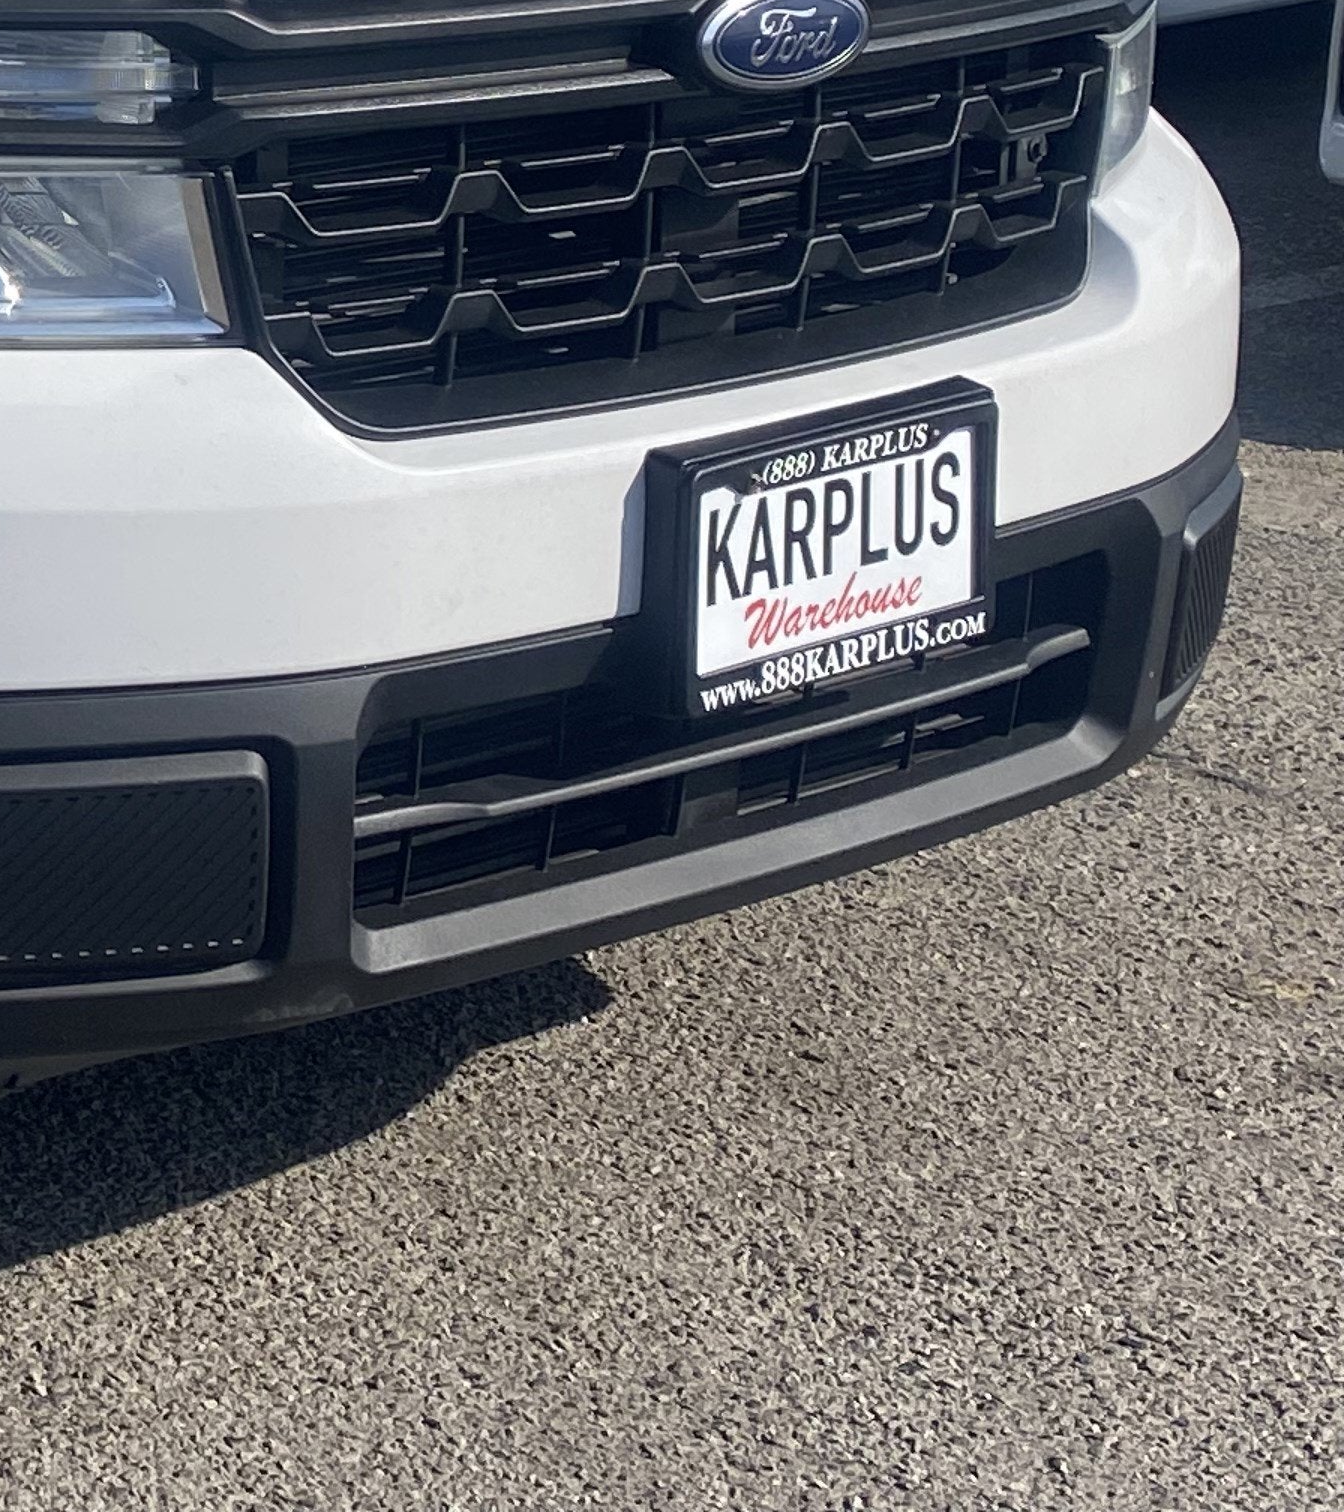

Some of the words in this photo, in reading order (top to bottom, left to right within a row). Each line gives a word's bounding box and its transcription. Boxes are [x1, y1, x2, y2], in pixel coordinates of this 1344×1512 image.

[750, 6, 839, 68] Ford
[762, 450, 816, 486] (888)
[821, 423, 929, 475] KARPLUS
[706, 451, 962, 607] KARPLUS
[744, 571, 923, 650] Warehouse
